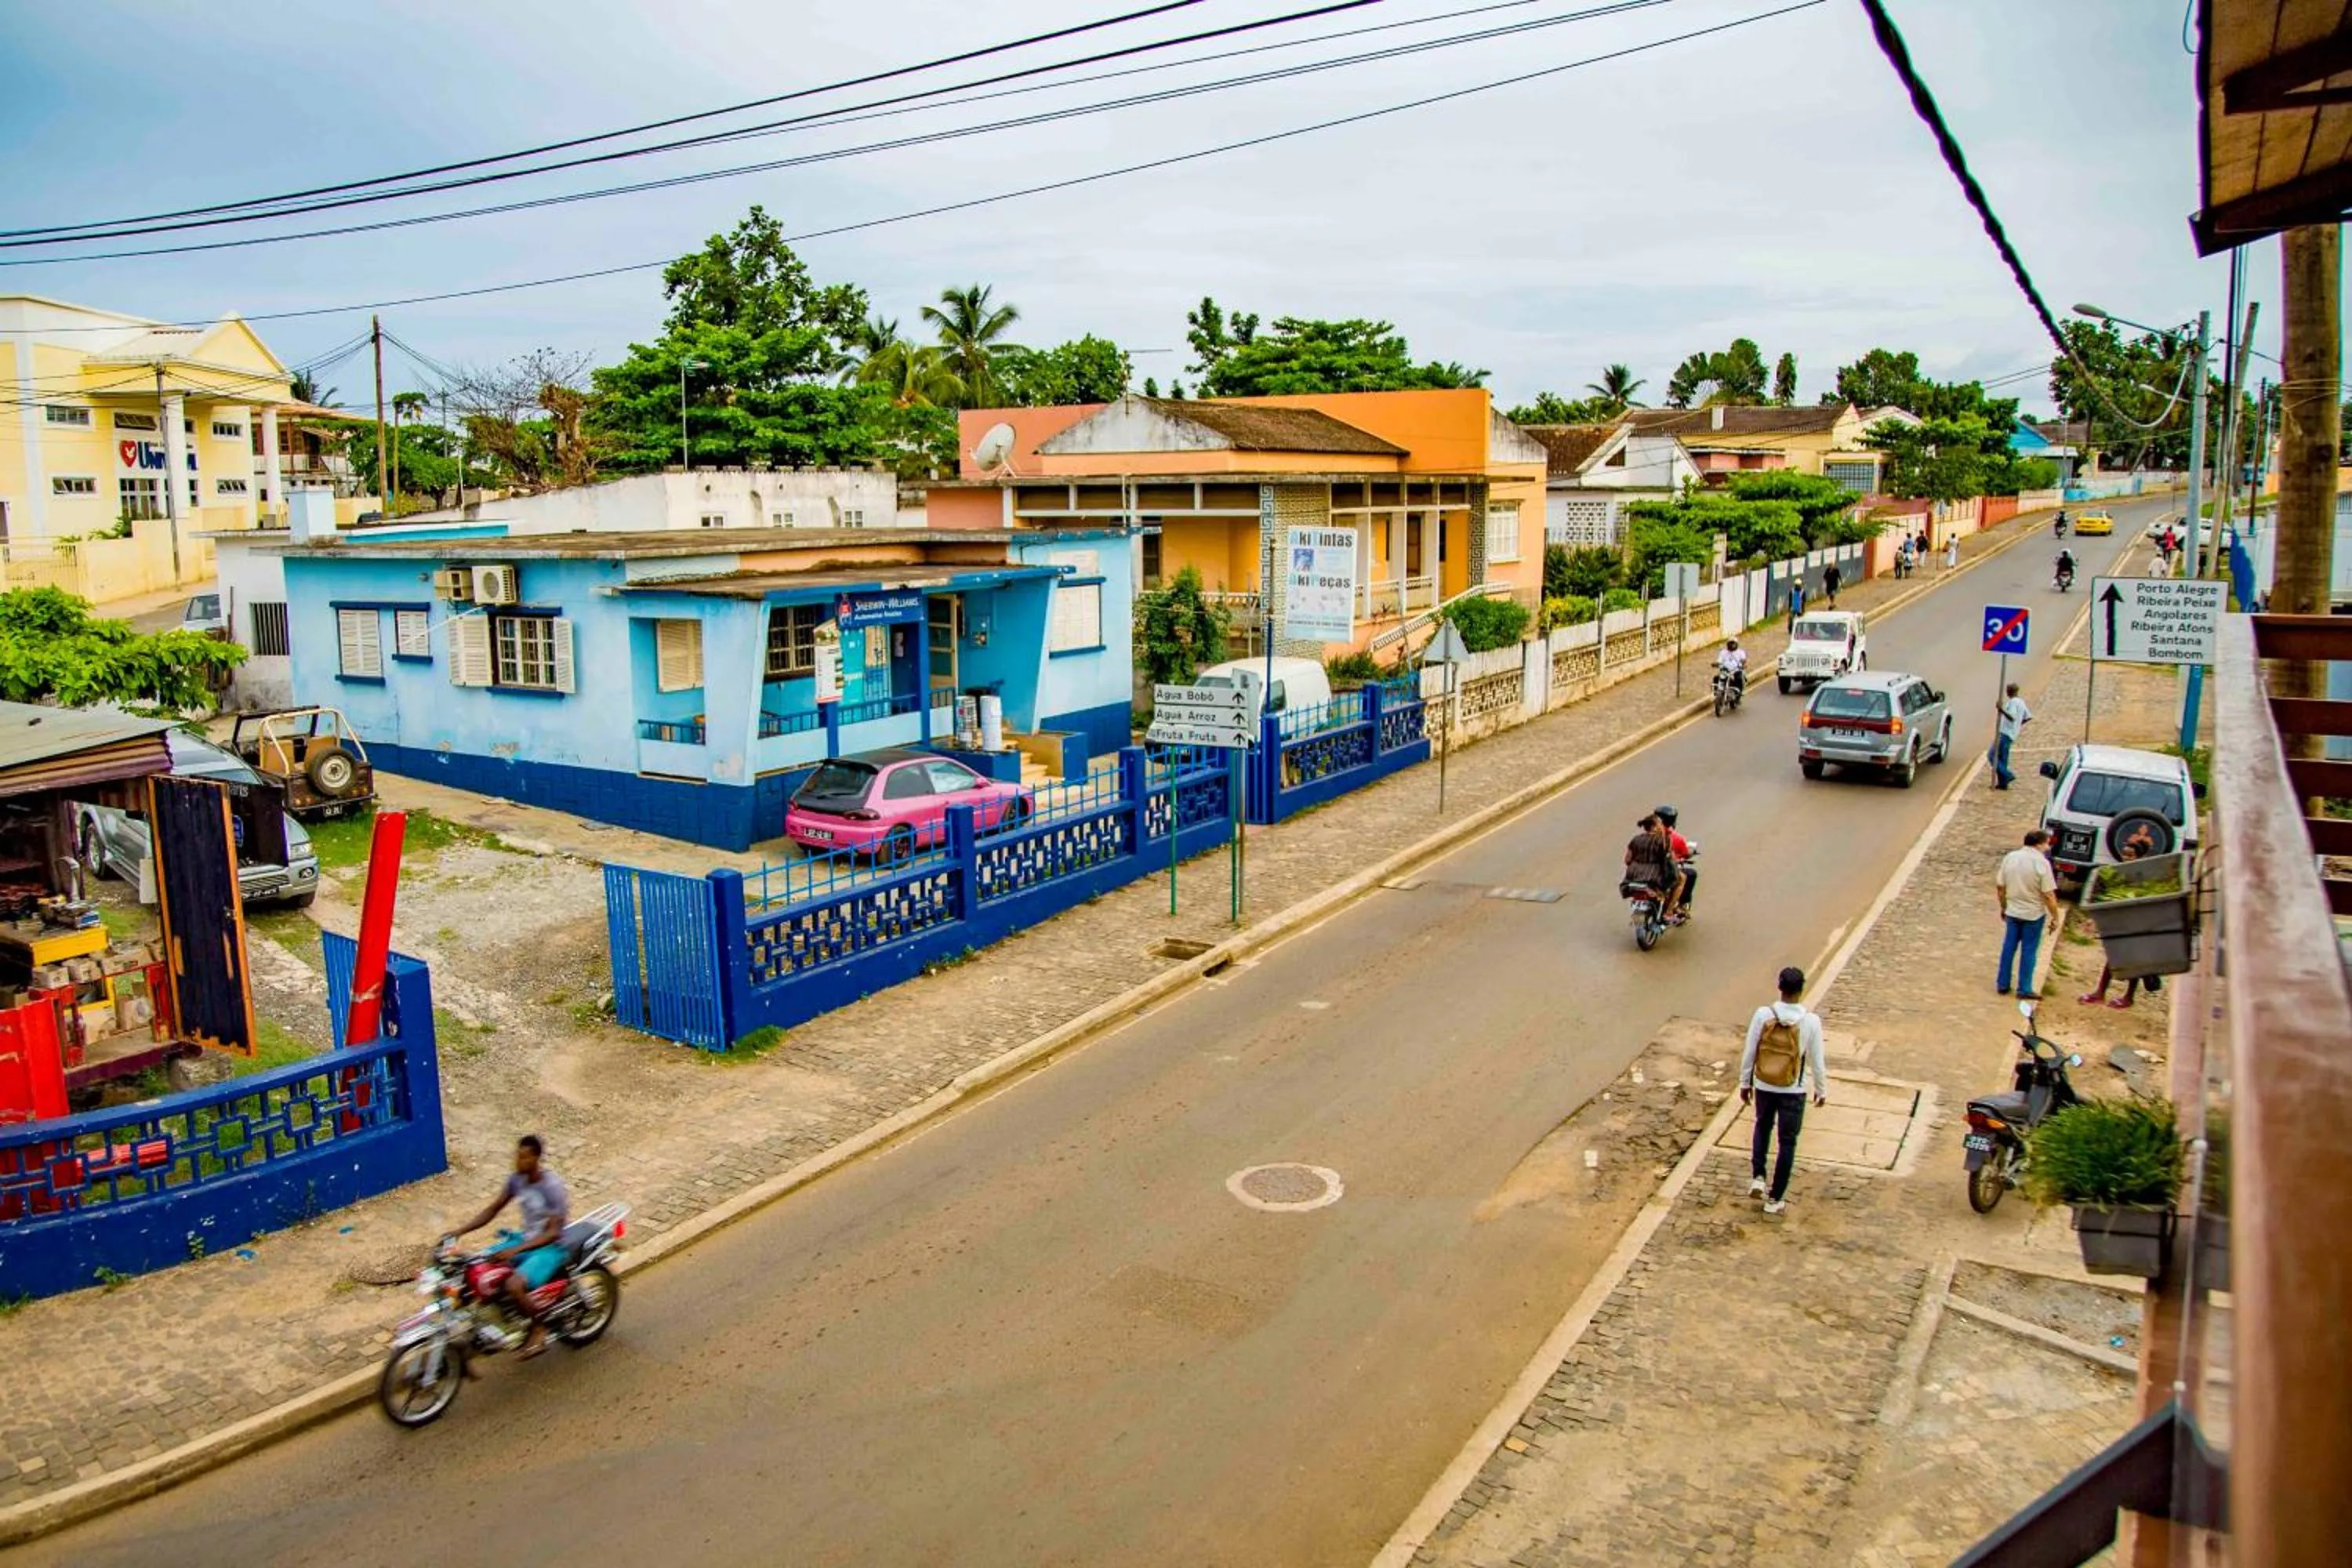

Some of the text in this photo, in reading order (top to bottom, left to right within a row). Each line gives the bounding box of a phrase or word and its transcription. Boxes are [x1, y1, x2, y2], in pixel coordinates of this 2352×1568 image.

[2136, 583, 2218, 596] Porto Alegre
[2136, 595, 2217, 608] Ribeira Peixe
[2144, 609, 2208, 621] Angolares
[2130, 621, 2215, 634] Ribeira Afons
[2150, 634, 2202, 646] Santana
[2148, 648, 2204, 659] Bombom
[1188, 711, 1216, 722] Arroz
[1156, 728, 1217, 742] Fruta Fruta
